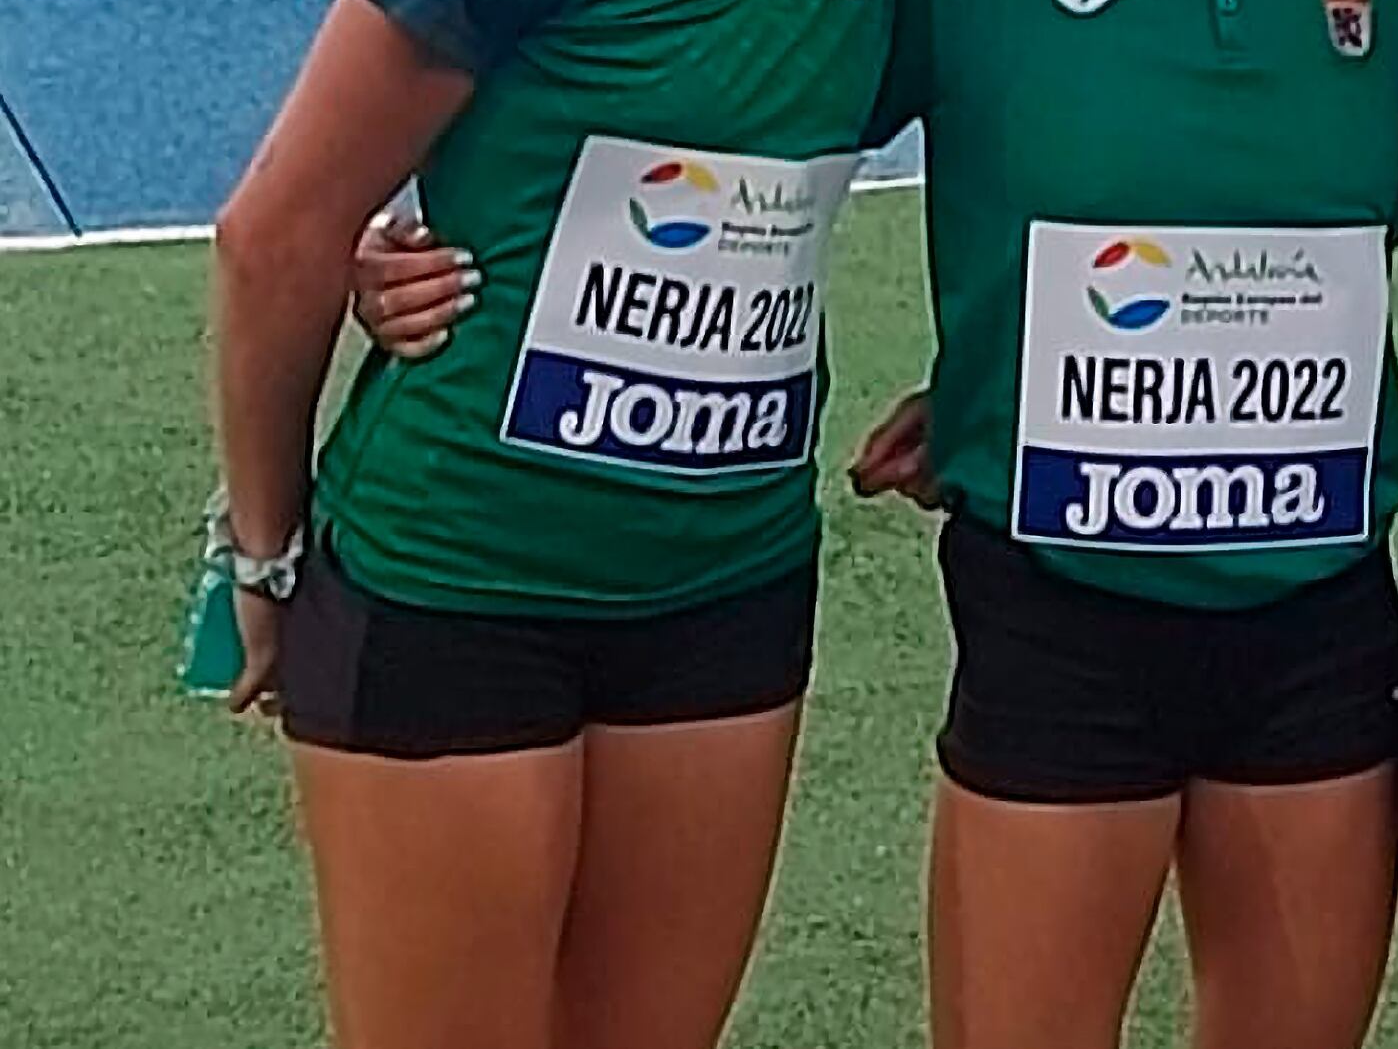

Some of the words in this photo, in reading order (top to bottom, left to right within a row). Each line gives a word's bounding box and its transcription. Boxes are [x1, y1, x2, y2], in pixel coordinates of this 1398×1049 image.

[575, 263, 737, 352] NERJA
[1061, 355, 1216, 424] NERJA
[1230, 358, 1347, 423] 2022
